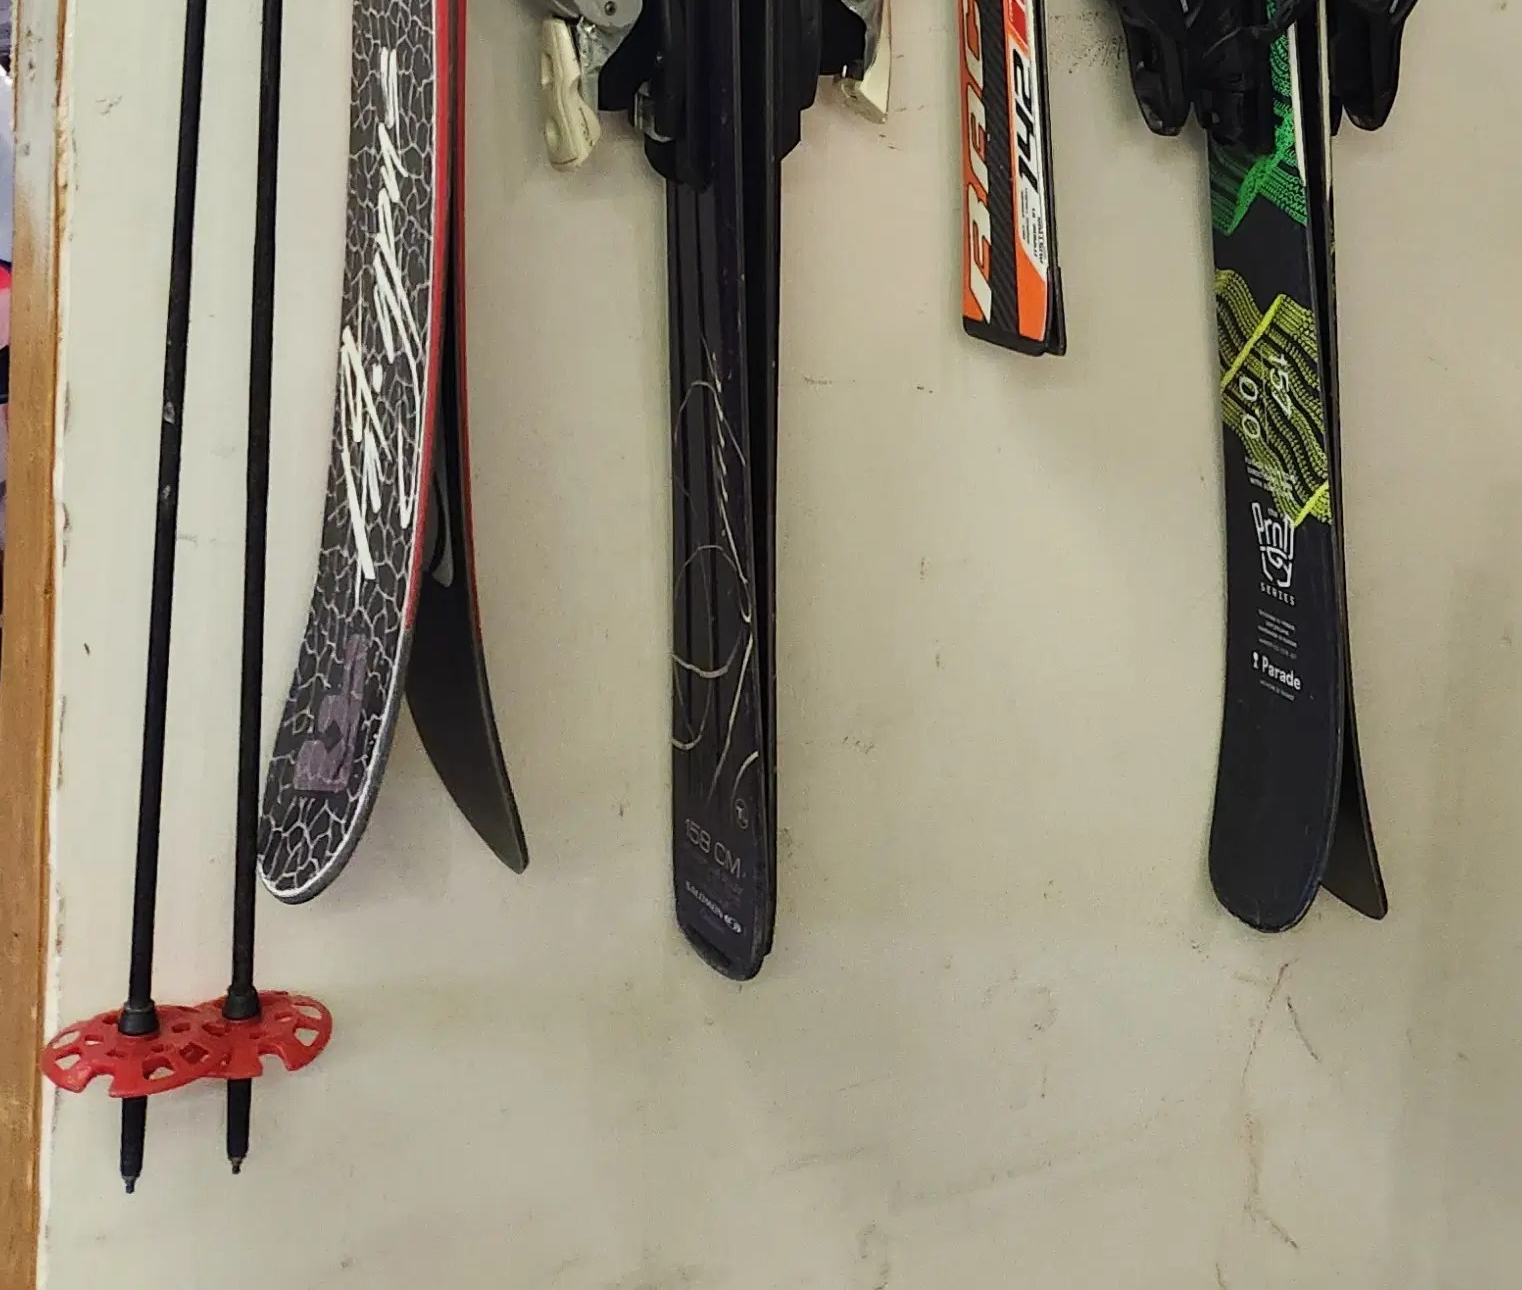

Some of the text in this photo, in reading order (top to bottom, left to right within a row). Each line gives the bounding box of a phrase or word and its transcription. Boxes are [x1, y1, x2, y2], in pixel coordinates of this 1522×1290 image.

[1013, 47, 1038, 196] 142
[1260, 581, 1296, 606] SERIES
[1262, 655, 1301, 691] Parade
